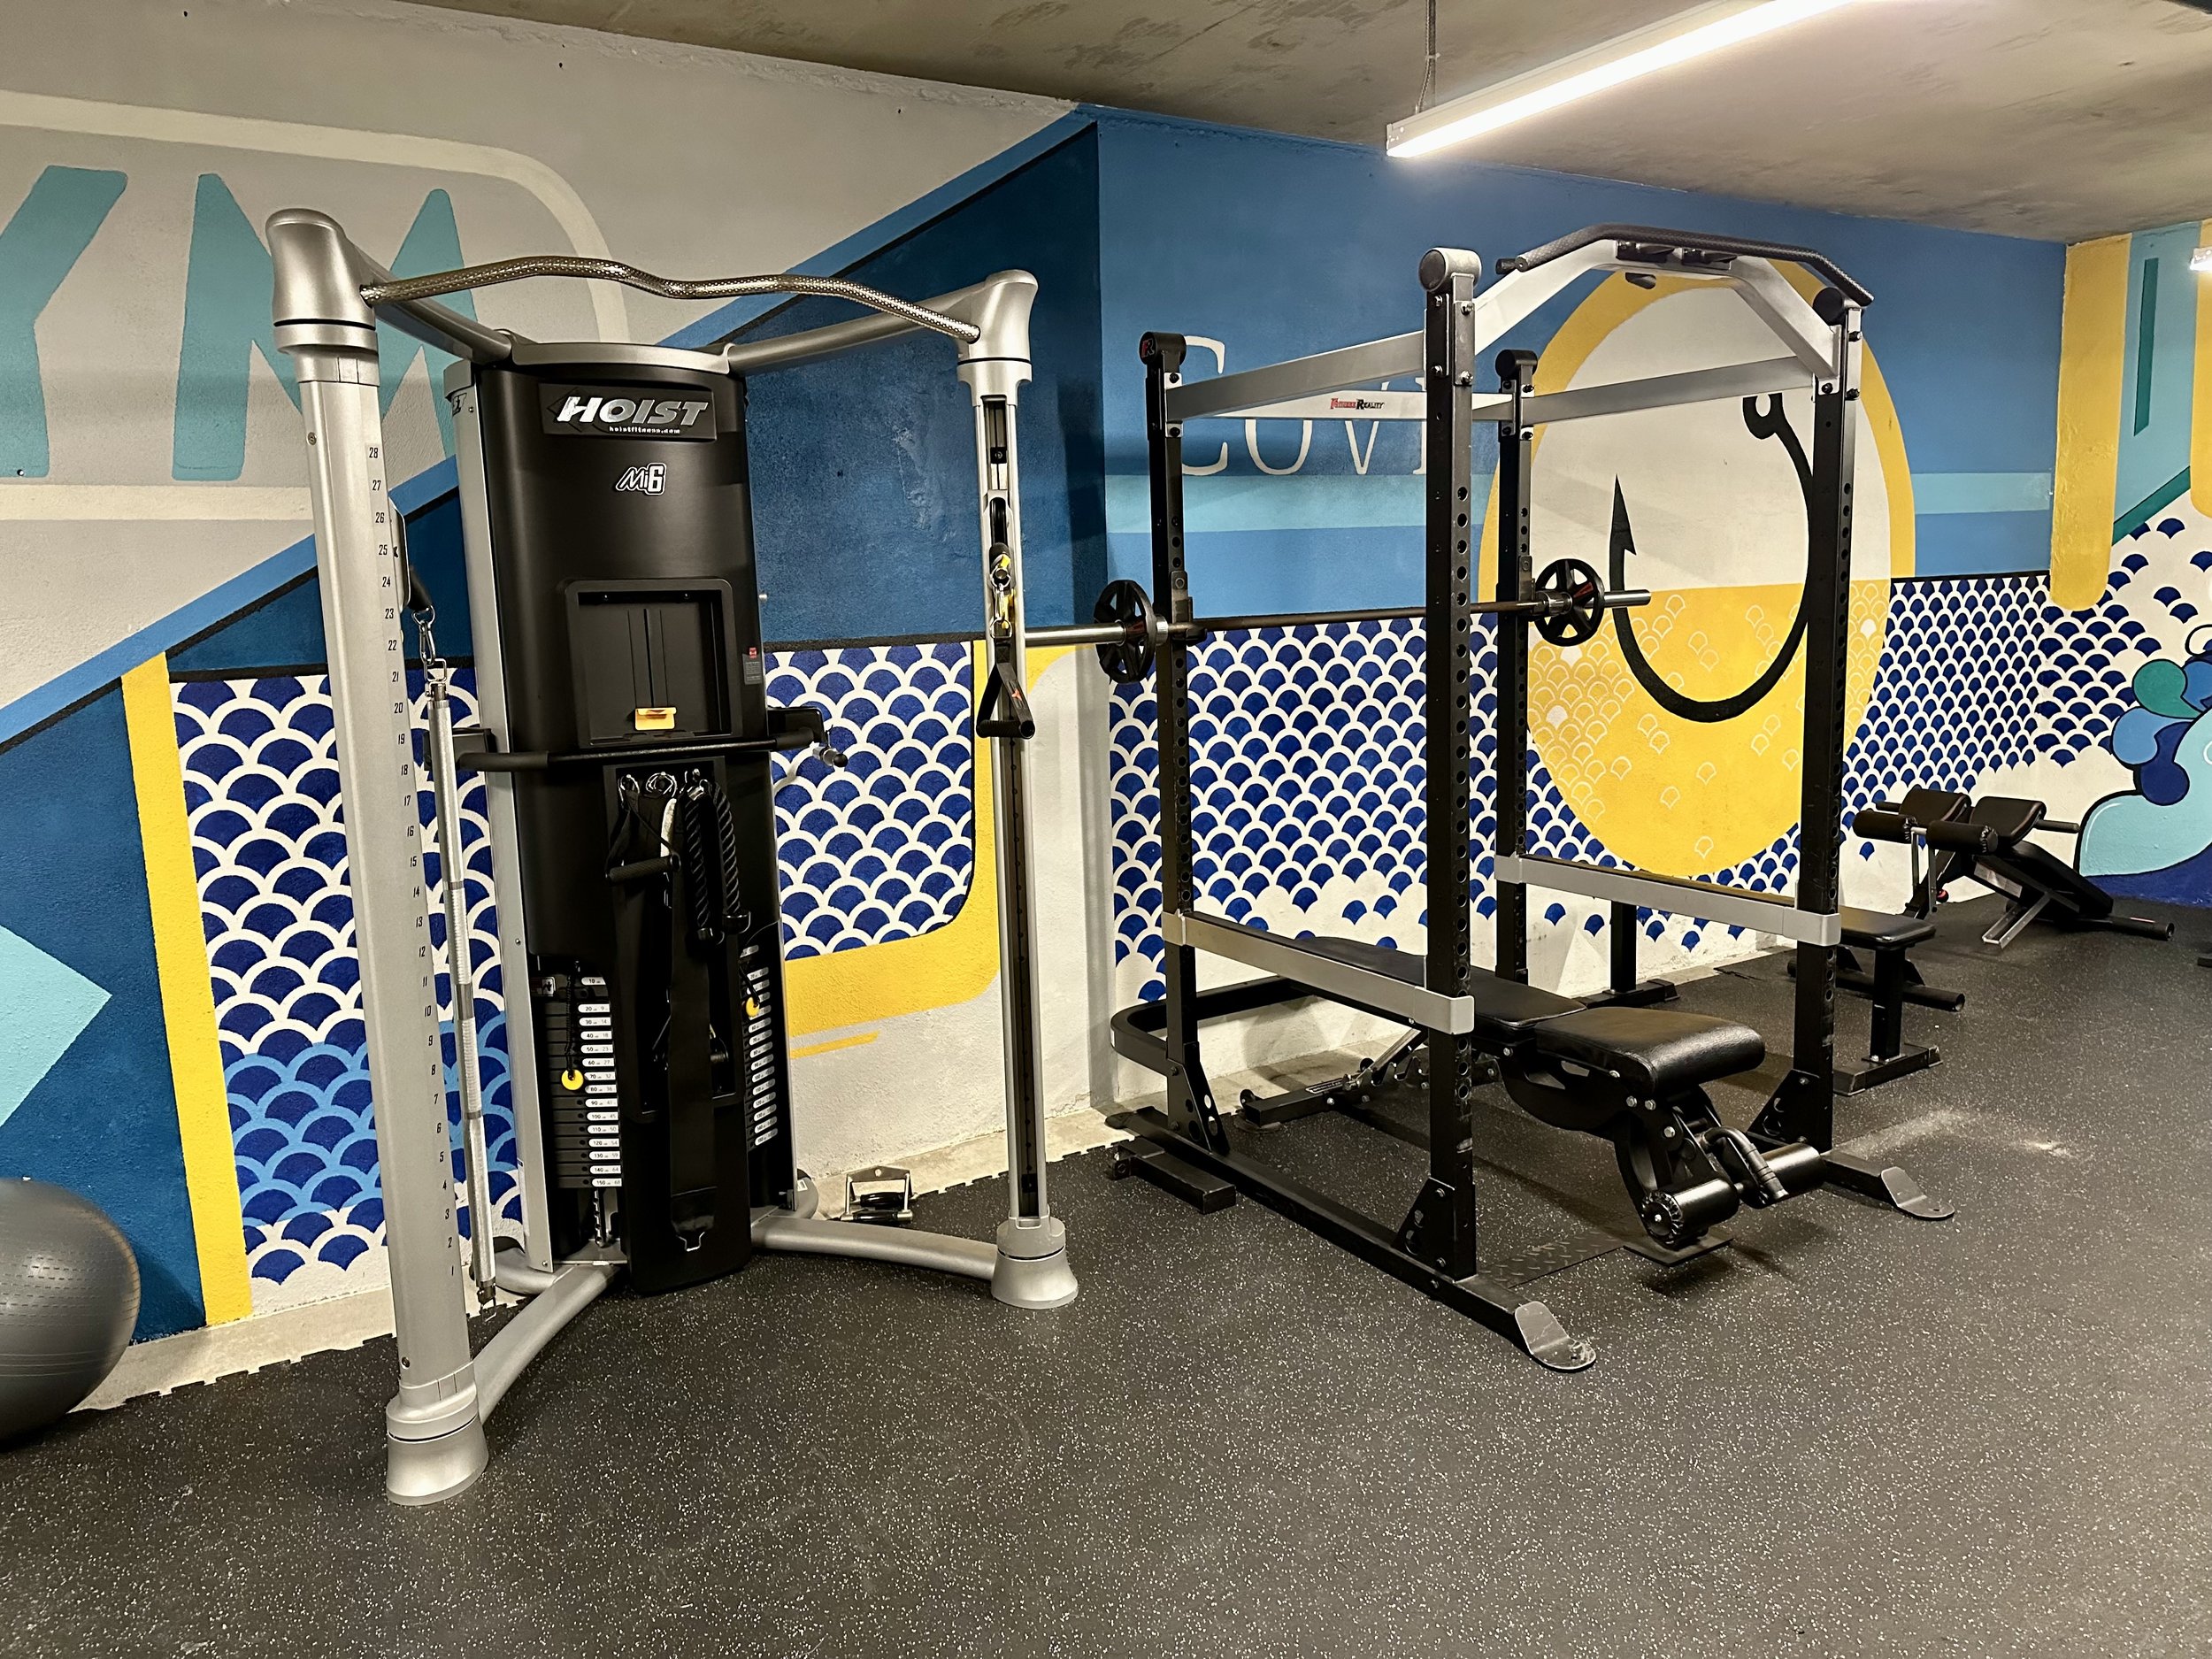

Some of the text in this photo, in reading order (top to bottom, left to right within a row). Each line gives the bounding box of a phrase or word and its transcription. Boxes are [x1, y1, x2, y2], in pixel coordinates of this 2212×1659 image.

[557, 396, 709, 426] HOIST
[368, 447, 379, 459] 28
[616, 463, 667, 495] Mi6
[372, 480, 382, 491] 27
[374, 511, 385, 524] 26
[378, 543, 388, 557] 25
[381, 576, 391, 588] 24
[384, 608, 395, 619] 23
[388, 639, 397, 651] 22
[391, 671, 399, 682] 21
[394, 703, 403, 714] 20
[397, 733, 405, 745] 19
[400, 764, 409, 776] 18
[403, 795, 411, 807] 17
[406, 826, 415, 837] 16
[410, 856, 418, 868] 15
[412, 886, 420, 898] 14
[415, 916, 423, 927] 13
[418, 946, 426, 958] 12
[422, 976, 428, 987] 11
[424, 1005, 432, 1018] 10
[427, 1035, 434, 1047] 9
[430, 1064, 436, 1076] 8
[434, 1094, 439, 1105] 7
[436, 1123, 442, 1133] 6
[439, 1151, 444, 1164] 5
[442, 1179, 448, 1190] 4
[444, 1208, 450, 1220] 3
[448, 1236, 453, 1248] 2
